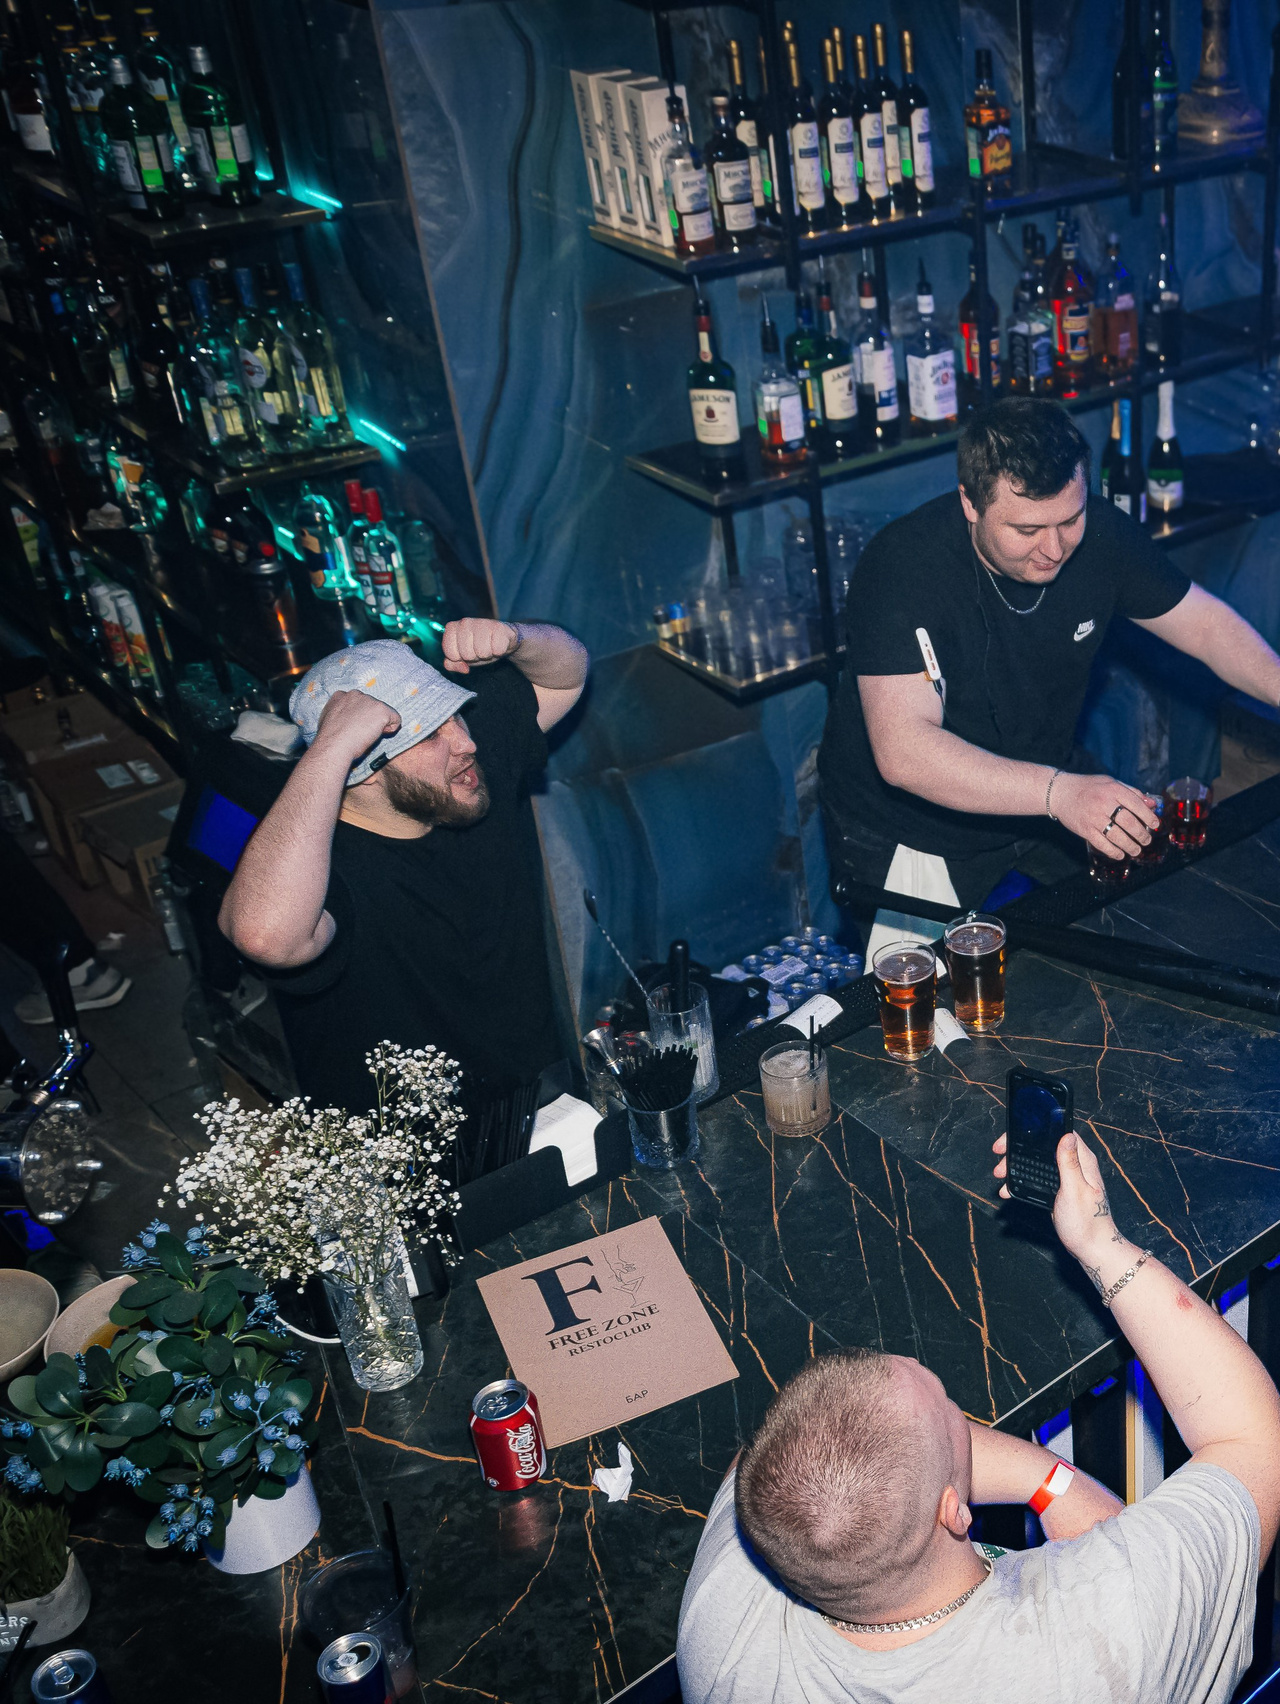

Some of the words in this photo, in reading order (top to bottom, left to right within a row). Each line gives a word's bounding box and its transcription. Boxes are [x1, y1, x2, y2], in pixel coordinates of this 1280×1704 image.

[521, 1255, 603, 1336] F
[548, 1324, 600, 1351] FREE
[602, 1303, 660, 1332] ZONE
[568, 1321, 653, 1357] RESTOCLUB
[625, 1388, 649, 1404] БАР
